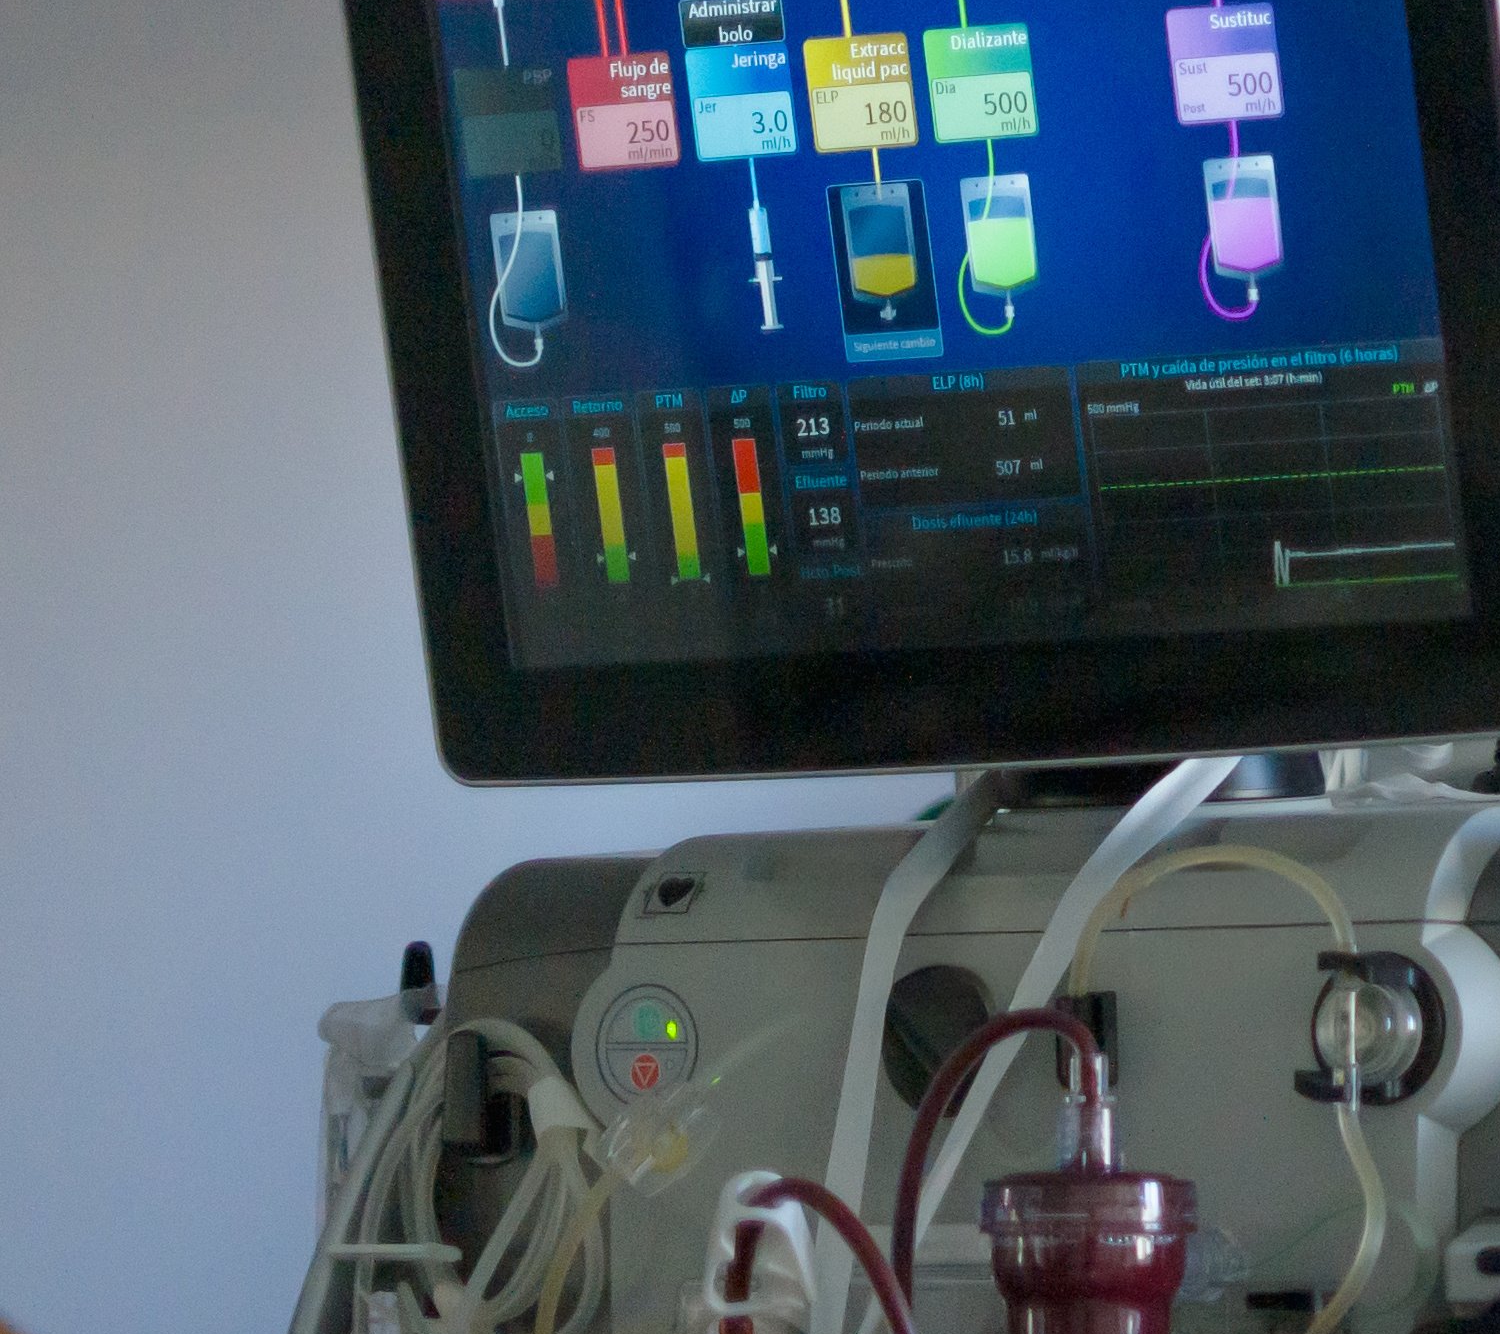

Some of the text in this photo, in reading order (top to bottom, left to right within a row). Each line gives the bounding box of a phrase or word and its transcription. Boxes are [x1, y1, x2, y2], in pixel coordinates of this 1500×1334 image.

[1209, 10, 1272, 29] Sustituc
[718, 25, 753, 44] bolo
[950, 29, 1028, 51] Dializante
[850, 41, 906, 59] Extracc
[731, 50, 786, 69] Jeringa
[1178, 61, 1208, 76] Sust
[610, 57, 669, 81] Flujo de
[831, 62, 909, 84] liquid pac
[621, 81, 671, 100] sangre
[936, 81, 956, 95] Dia
[1228, 71, 1273, 97] 500
[816, 91, 839, 105] ELP
[984, 90, 1028, 116] 500
[1245, 98, 1276, 114] ml/h
[580, 109, 595, 124] FS
[698, 101, 717, 115] Jer
[865, 100, 907, 126] 180
[751, 109, 788, 134] 3.0
[1001, 117, 1031, 134] ml/h
[626, 119, 670, 145] 250
[880, 126, 910, 142] ml/h
[762, 135, 791, 151] ml/h
[628, 144, 673, 162] ml/min
[853, 336, 936, 354] Siguiente cambio
[1120, 345, 1399, 379] PTM y caída de presión en el filtro (6 horas)
[932, 374, 985, 390] ELP (8h)
[1185, 378, 1207, 391] Vida
[1226, 375, 1243, 388] del
[1393, 382, 1415, 395] PTM
[655, 392, 684, 409] PTM
[793, 385, 828, 400] Filtro
[505, 403, 550, 419] Acceso
[572, 399, 624, 414] Retorno
[796, 416, 831, 438] 213
[894, 416, 924, 430] actual
[998, 409, 1037, 427] 51 ml
[900, 466, 939, 479] anterior
[995, 458, 1043, 476] 507 ml
[795, 473, 848, 490] Efluente
[808, 506, 842, 527] 138
[911, 509, 1038, 530] Dosis efluente (24h)
